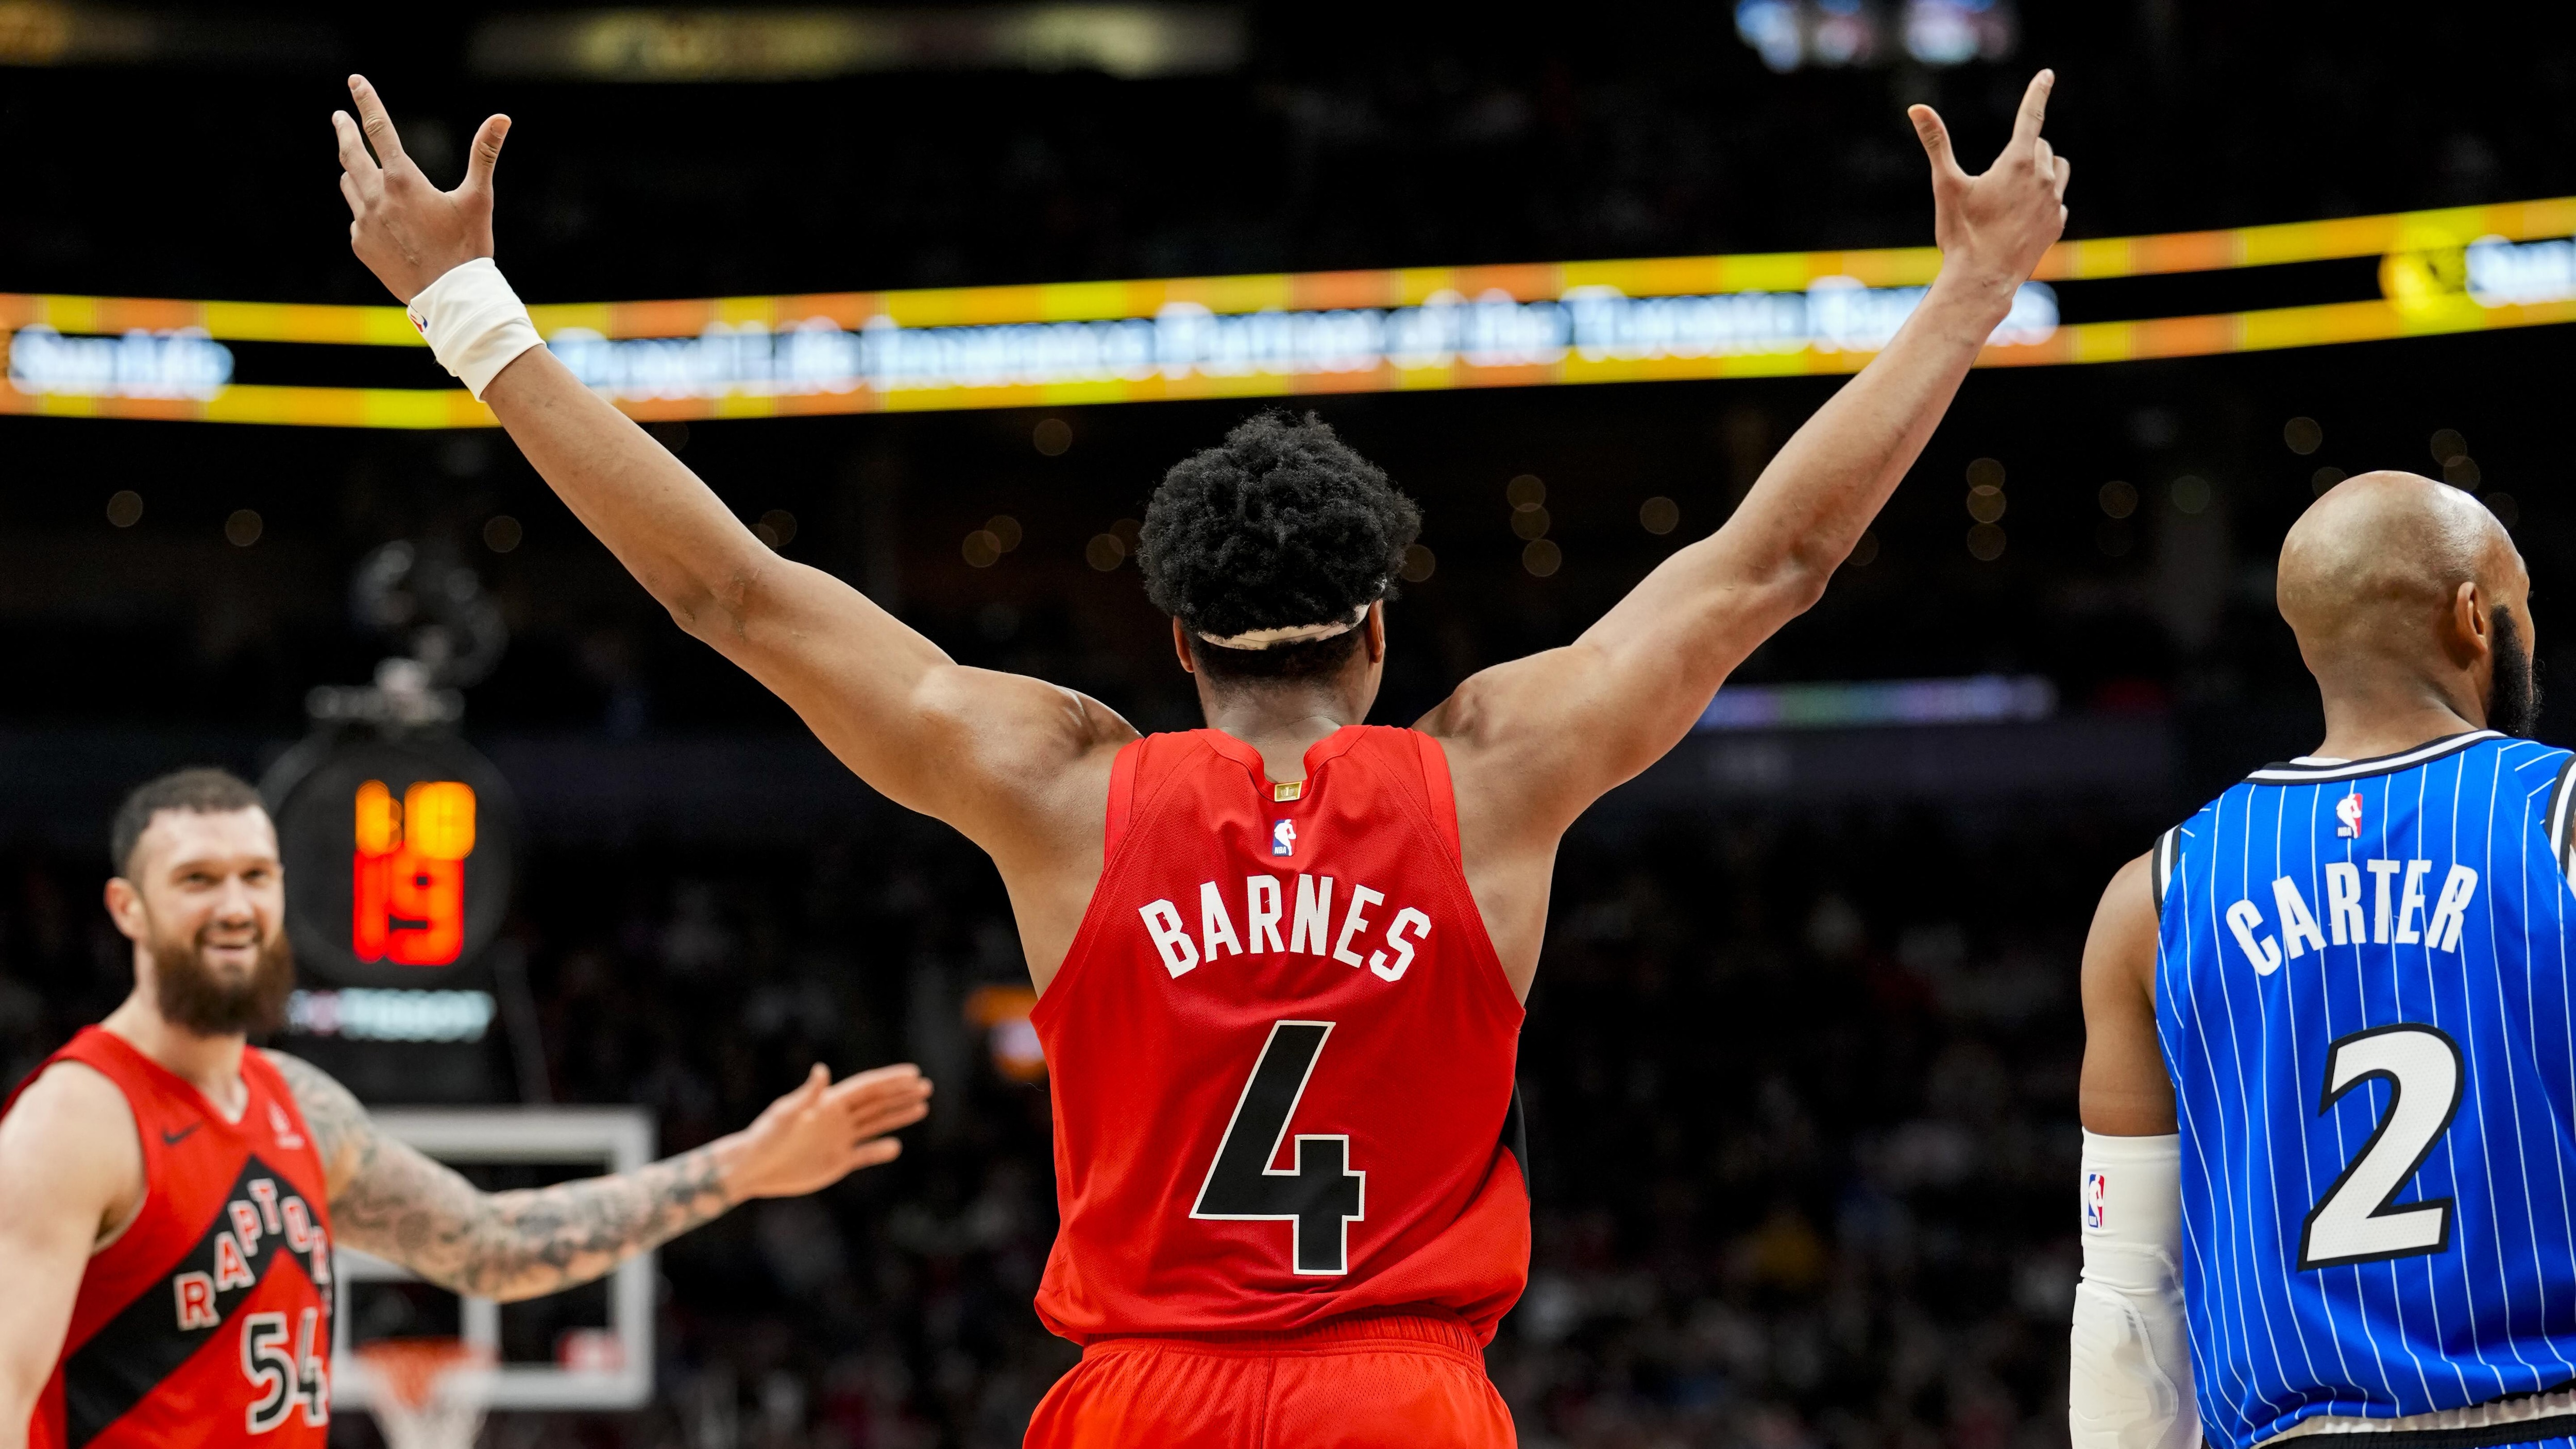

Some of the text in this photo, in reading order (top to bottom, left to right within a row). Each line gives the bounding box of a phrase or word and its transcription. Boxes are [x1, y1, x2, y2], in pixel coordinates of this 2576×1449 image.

[1138, 874, 1431, 982] BARNES
[2226, 859, 2478, 976] CARTER
[1189, 1020, 1366, 1275] 4
[2297, 1022, 2465, 1272] 2
[240, 1308, 329, 1435] 54
